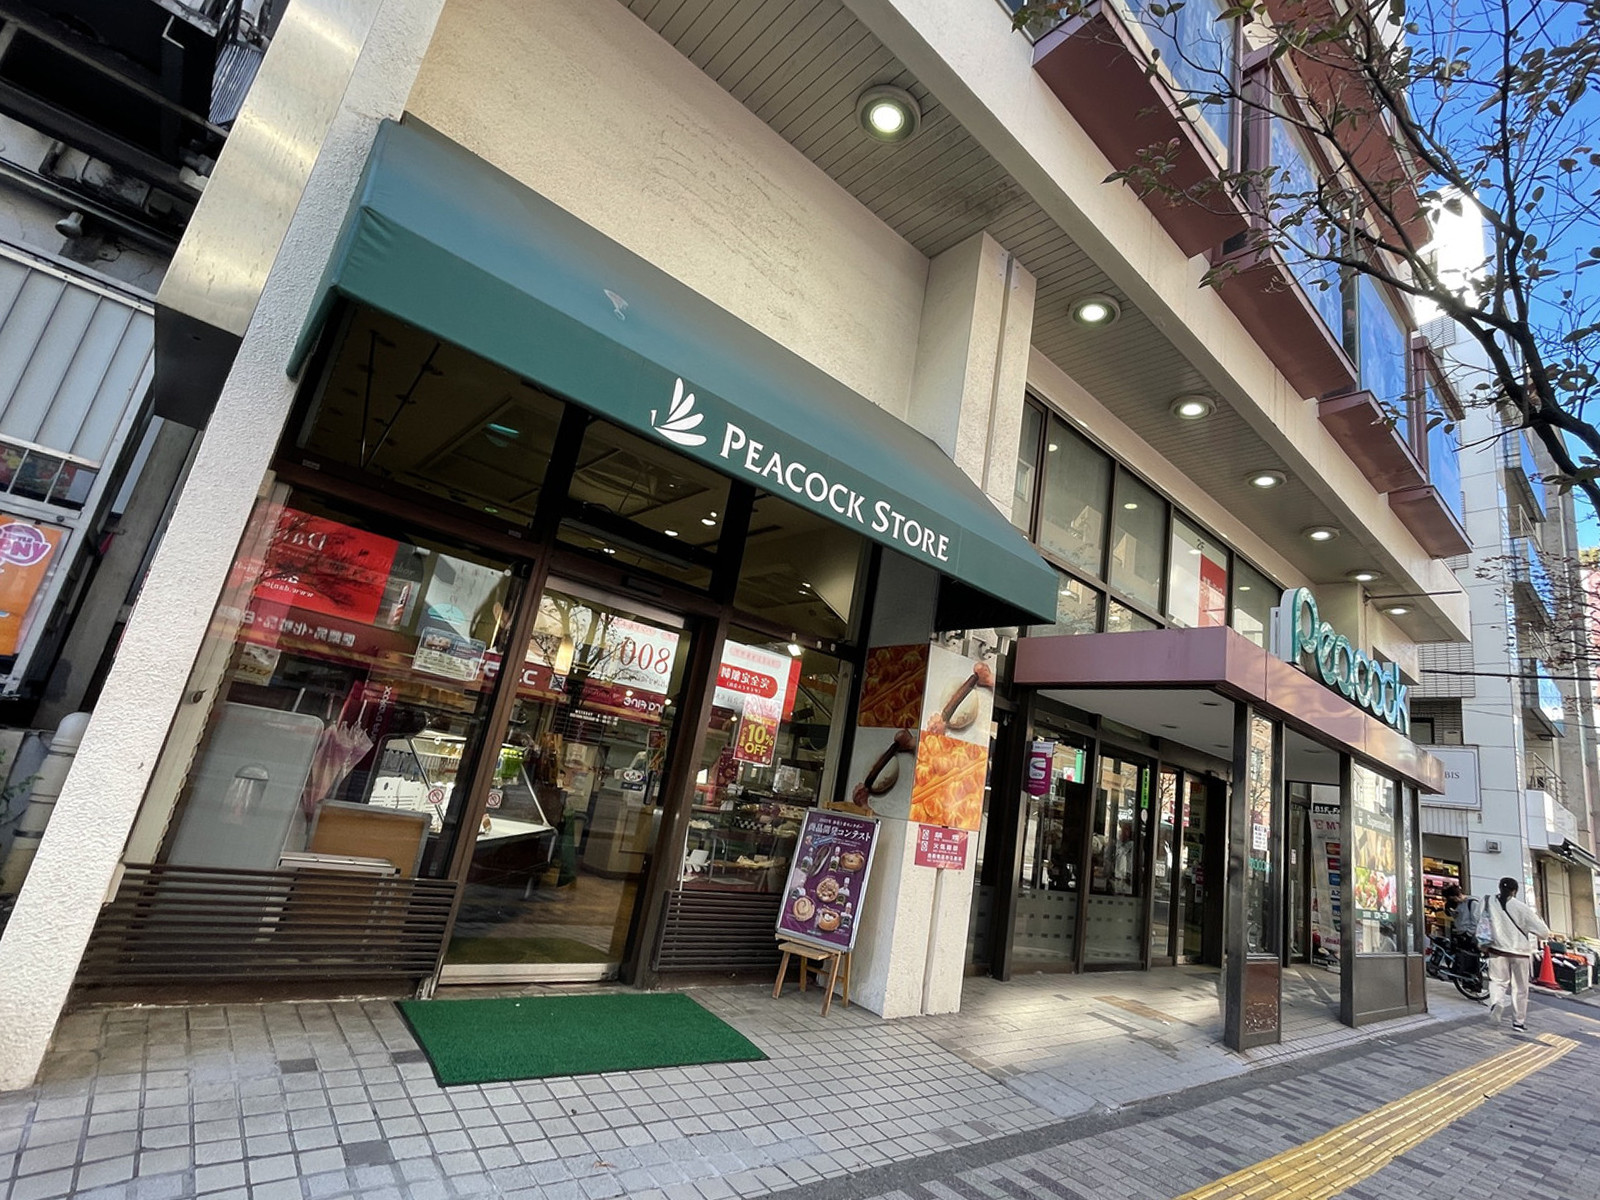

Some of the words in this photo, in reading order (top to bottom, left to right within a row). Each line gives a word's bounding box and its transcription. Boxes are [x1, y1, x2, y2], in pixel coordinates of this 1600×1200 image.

[719, 422, 866, 524] PEACOCK
[871, 500, 950, 563] STORE
[1289, 586, 1410, 736] Peacock
[744, 742, 768, 756] OFF
[748, 723, 775, 747] 10%
